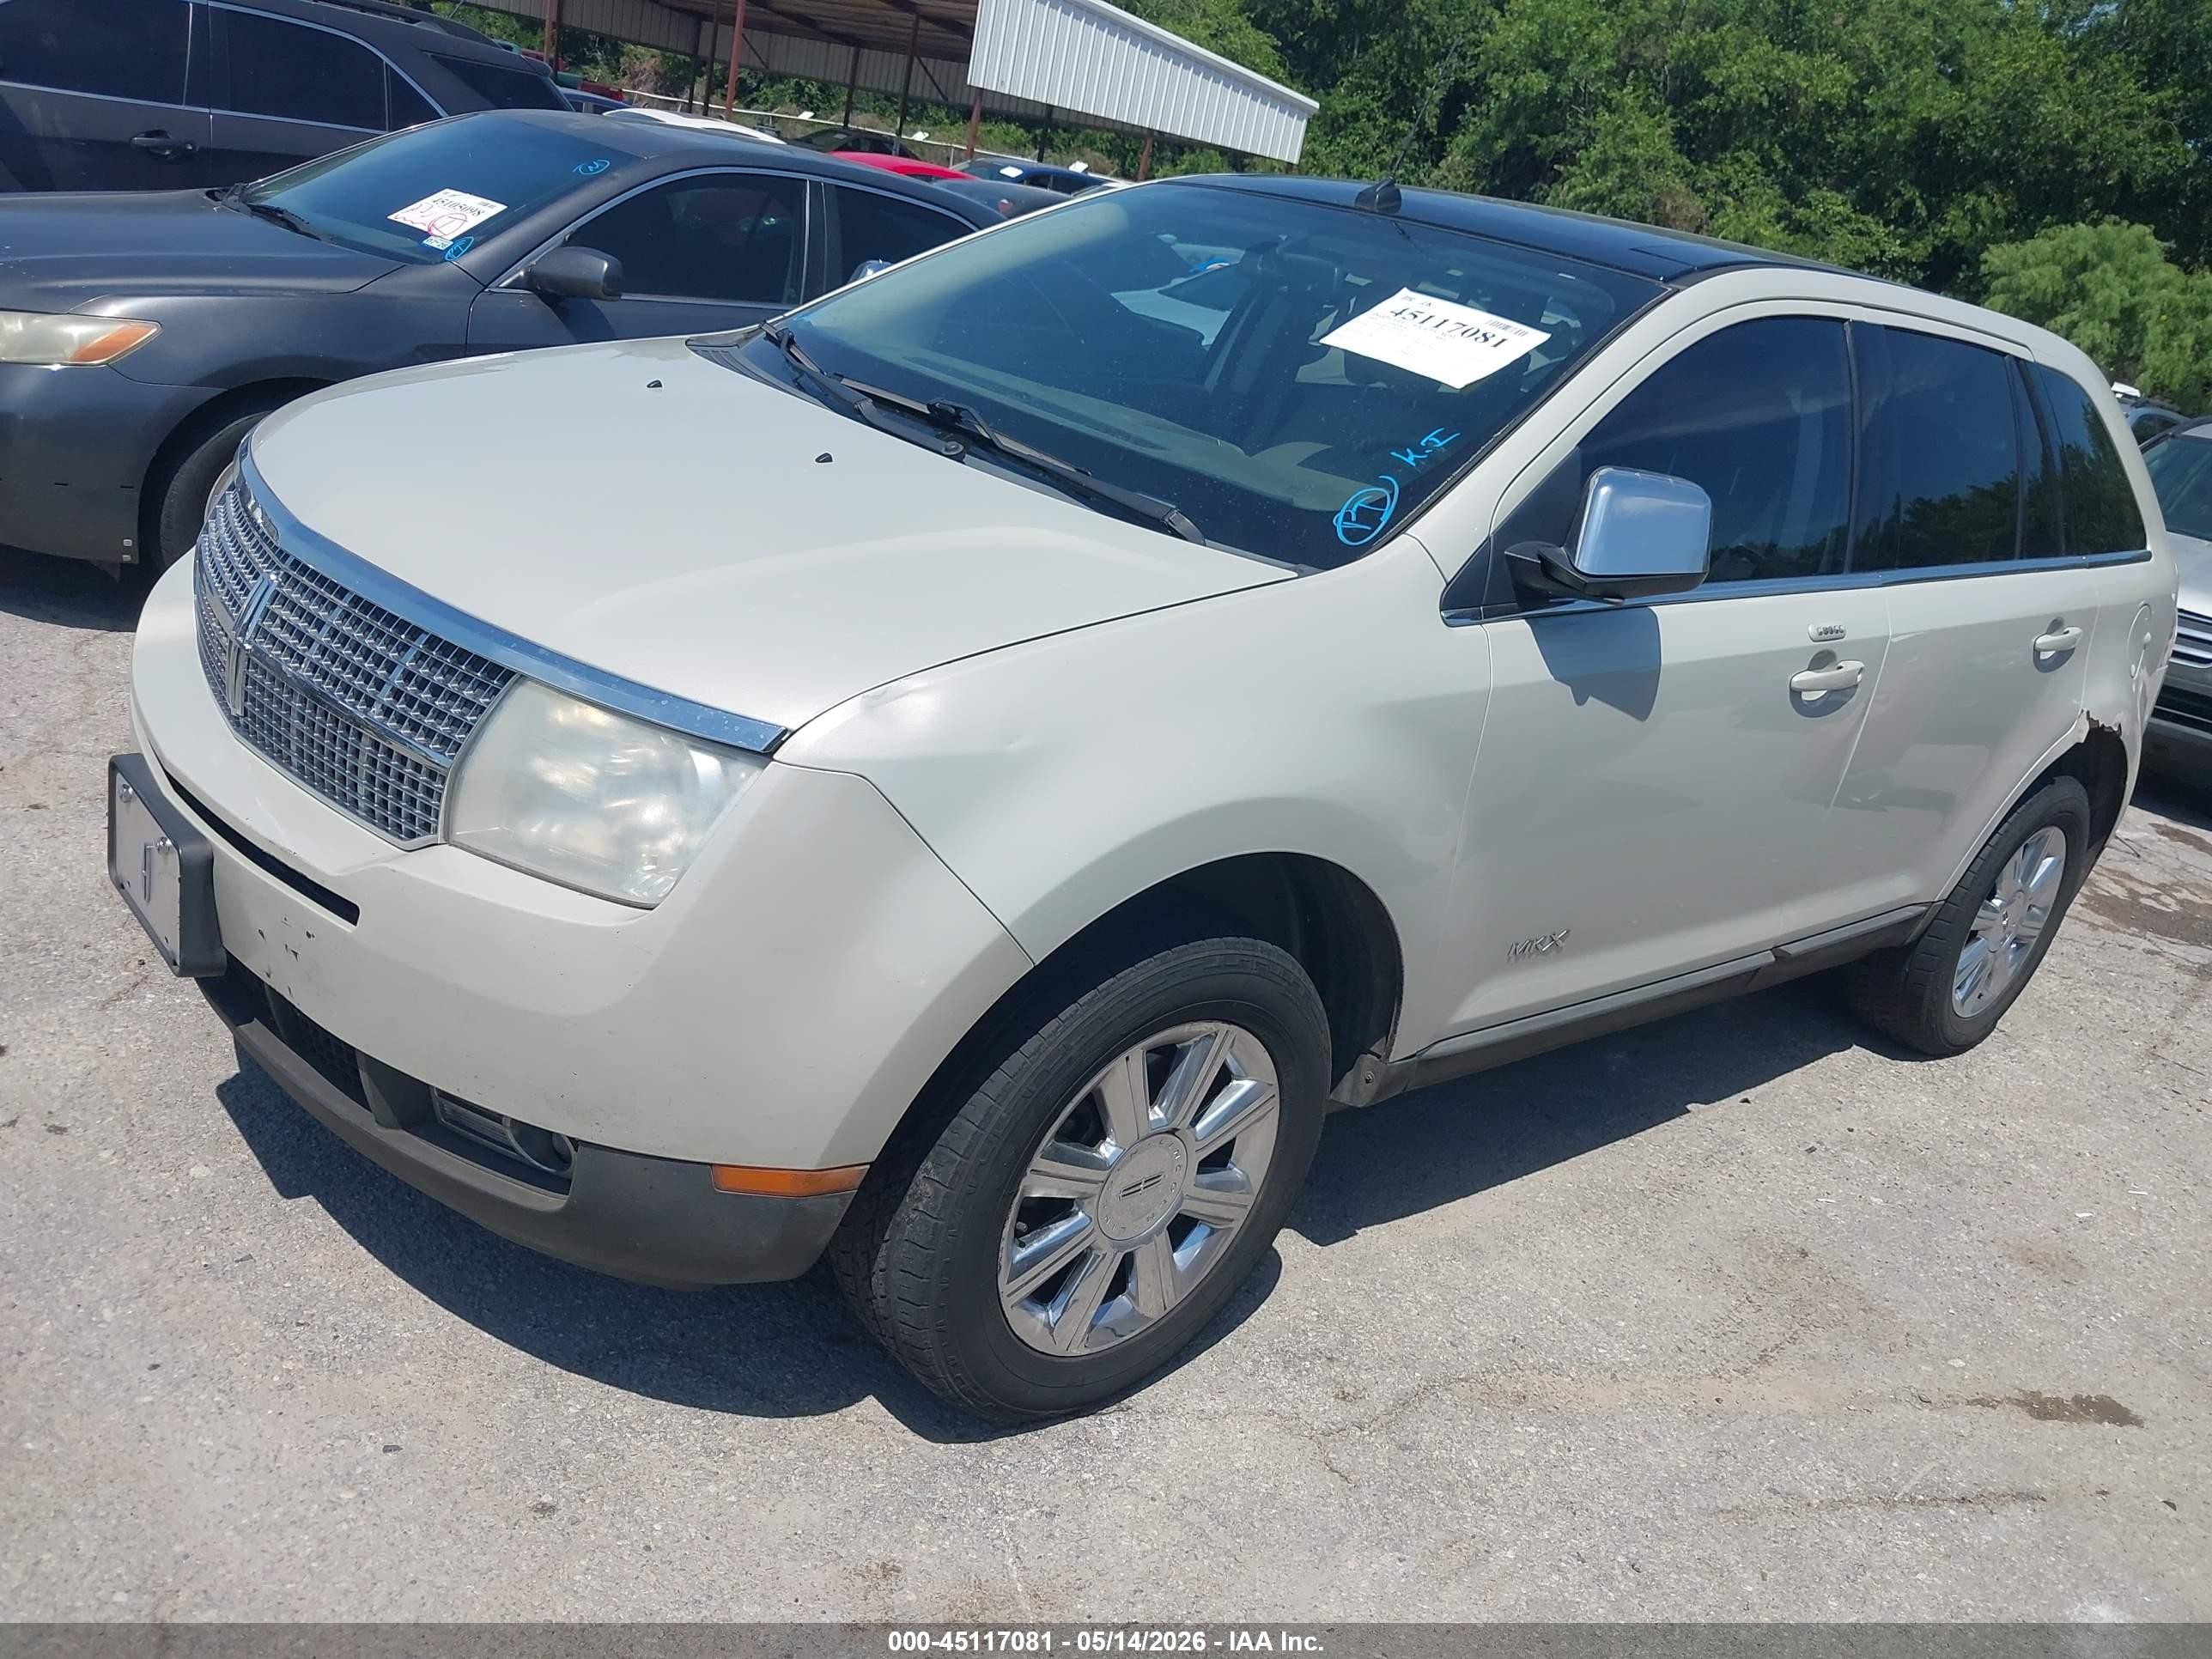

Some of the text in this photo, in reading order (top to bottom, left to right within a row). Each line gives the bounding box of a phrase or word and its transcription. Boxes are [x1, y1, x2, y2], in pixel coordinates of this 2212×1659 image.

[432, 198, 486, 217] 45105098
[1389, 307, 1509, 349] 45117081
[1507, 928, 1570, 957] MKX
